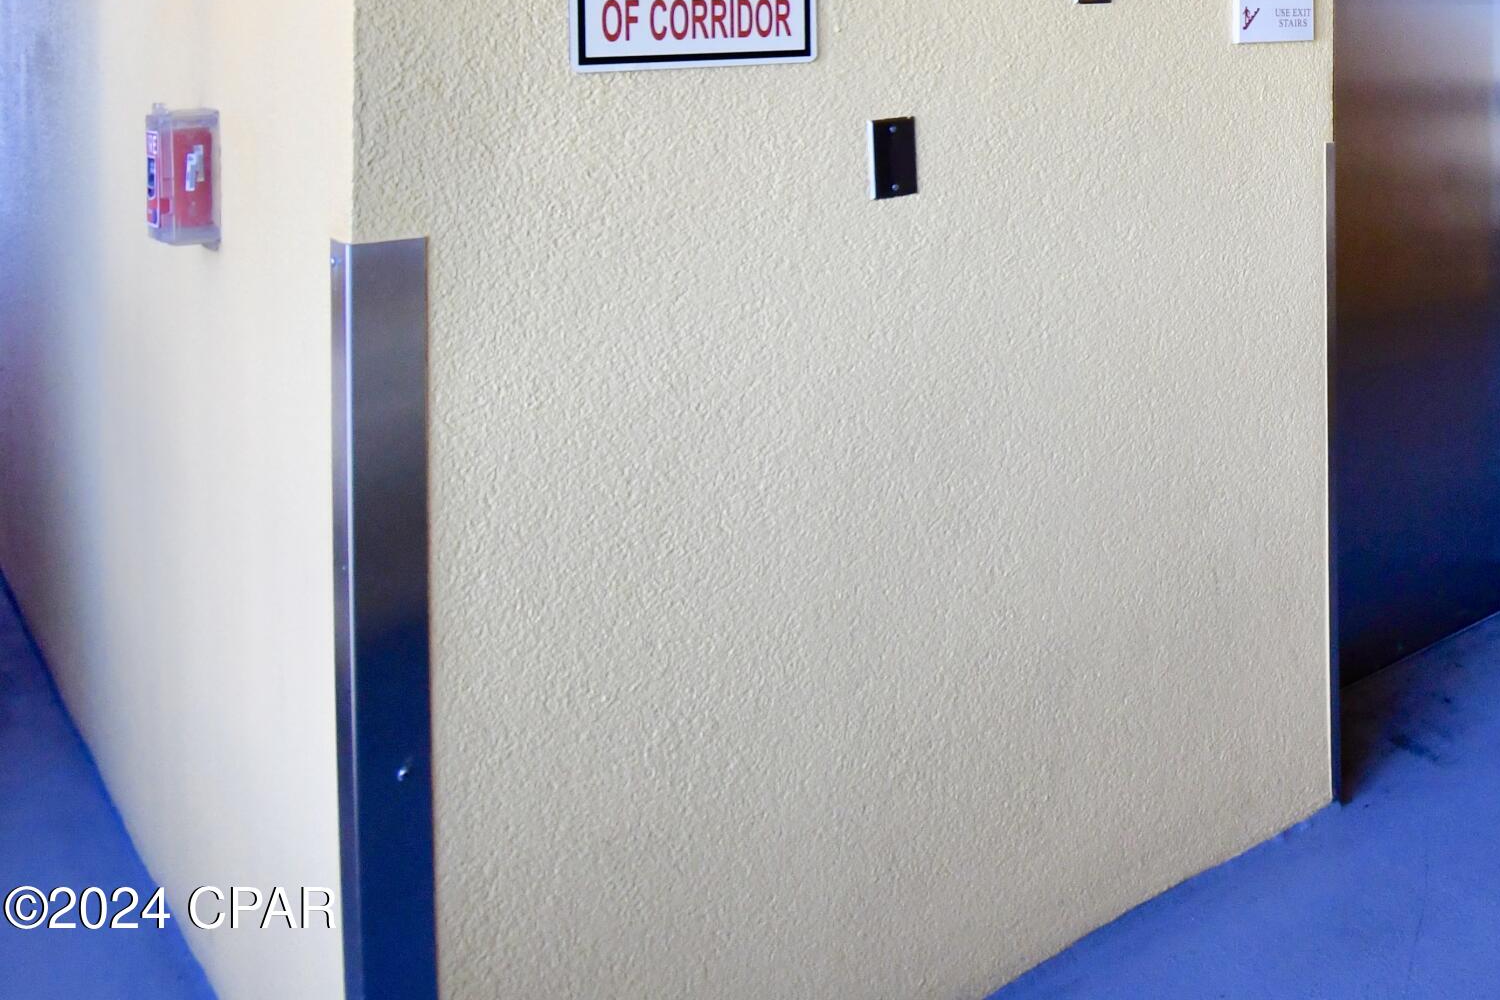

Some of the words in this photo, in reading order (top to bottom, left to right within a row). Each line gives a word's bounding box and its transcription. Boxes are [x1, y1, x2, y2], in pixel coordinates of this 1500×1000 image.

[1275, 8, 1291, 17] USE
[1292, 8, 1311, 17] EXIT
[1278, 19, 1308, 28] STAIRS
